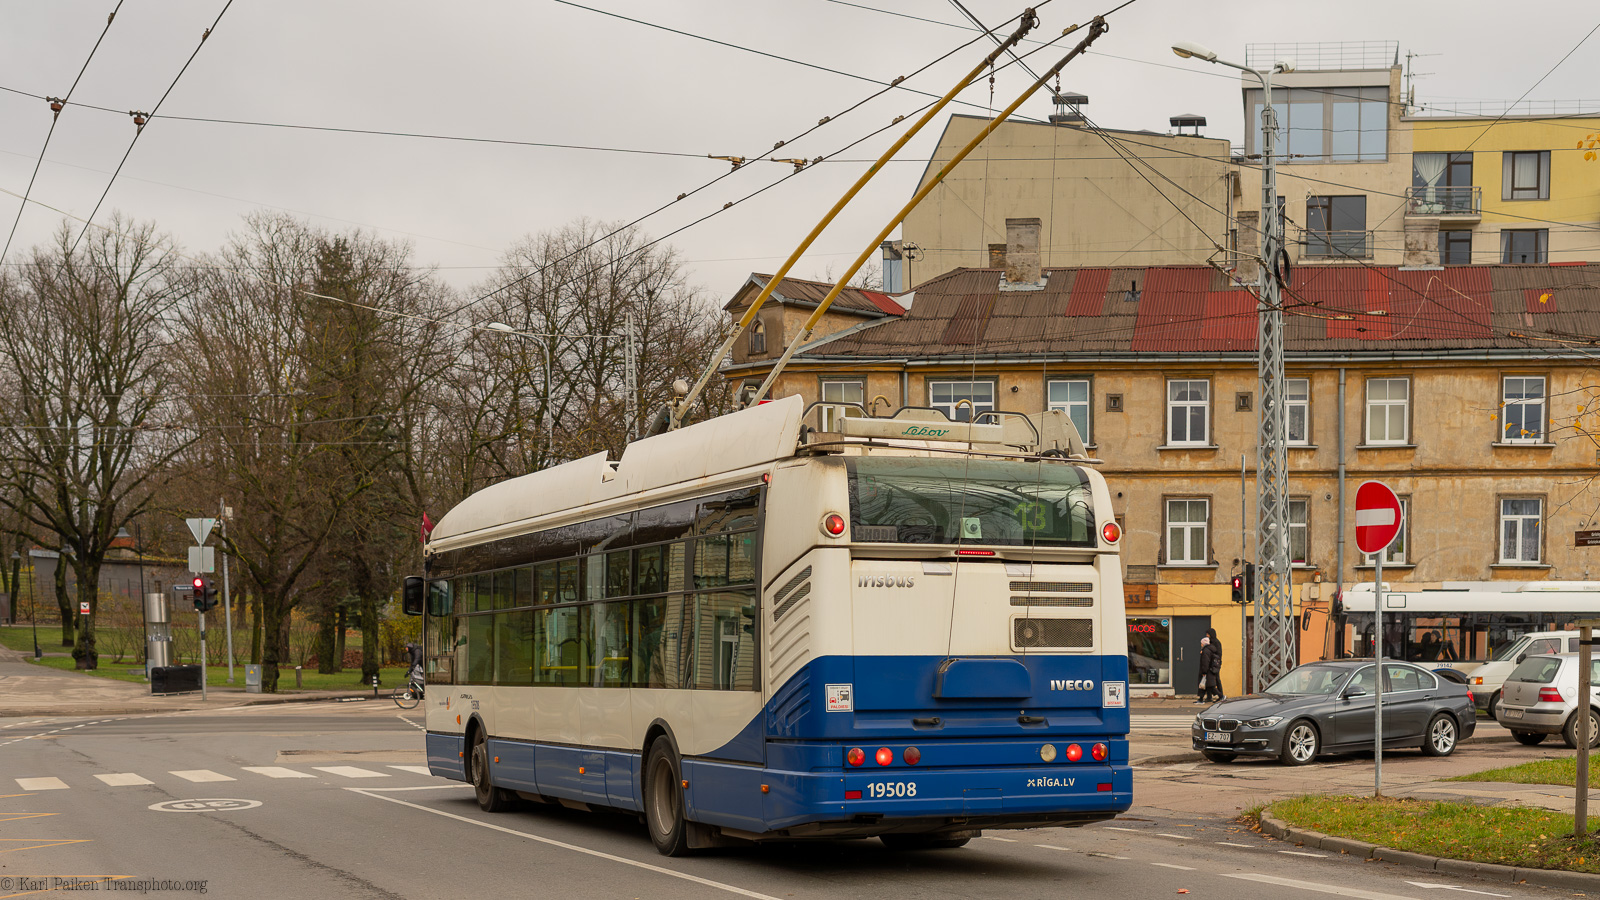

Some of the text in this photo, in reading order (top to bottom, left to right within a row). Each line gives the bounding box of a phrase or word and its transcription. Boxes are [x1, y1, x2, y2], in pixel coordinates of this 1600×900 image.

[902, 425, 949, 436] Lekov
[1014, 502, 1046, 530] 13
[1127, 594, 1140, 603] 33
[1128, 624, 1156, 633] TACOS
[1050, 680, 1094, 691] IVECO
[1037, 776, 1075, 787] RĪGA.LV
[867, 782, 917, 797] 19508
